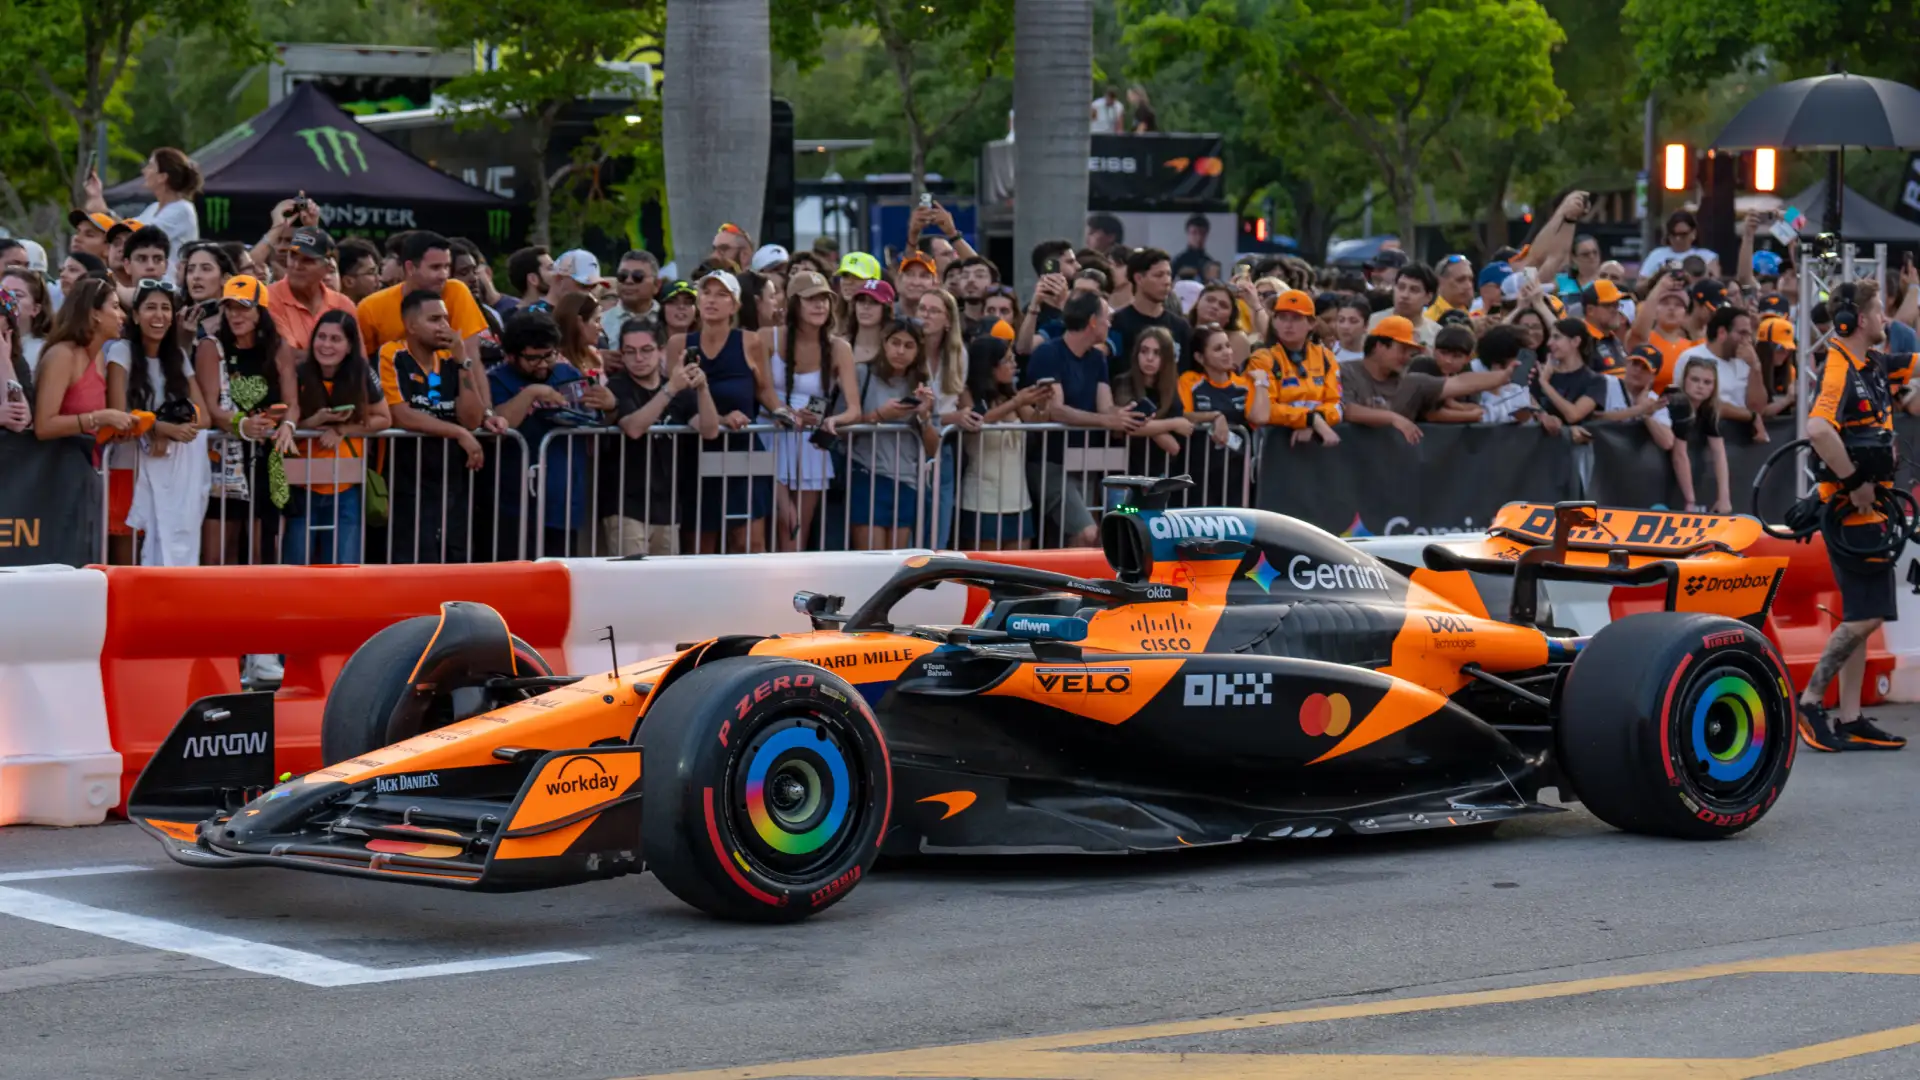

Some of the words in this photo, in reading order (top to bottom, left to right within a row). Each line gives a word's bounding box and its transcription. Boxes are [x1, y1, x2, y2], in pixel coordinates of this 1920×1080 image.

[1087, 157, 1137, 174] EISS
[319, 203, 417, 229] ONSTER
[0, 518, 41, 548] EN
[1149, 511, 1248, 541] allwyn
[1625, 514, 1718, 545] OKX
[1288, 554, 1389, 590] Gemini
[1146, 586, 1172, 599] okta
[1706, 574, 1771, 593] Dropbox
[1012, 619, 1050, 634] allwyn
[1424, 615, 1474, 634] DELL
[1140, 638, 1191, 651] CISCO
[1702, 629, 1745, 650] PIRELLI
[803, 653, 857, 669] HARD
[863, 648, 914, 665] MILLE
[927, 669, 952, 677] Bahrain
[1035, 674, 1130, 693] VELO
[1183, 672, 1273, 706] OKX
[718, 719, 731, 748] P
[735, 674, 815, 720] ZERO
[182, 731, 268, 759] ARROW
[375, 777, 399, 793] JACK
[399, 772, 438, 791] DANIEL'S
[546, 773, 619, 796] workday
[1696, 803, 1761, 827] ZERO
